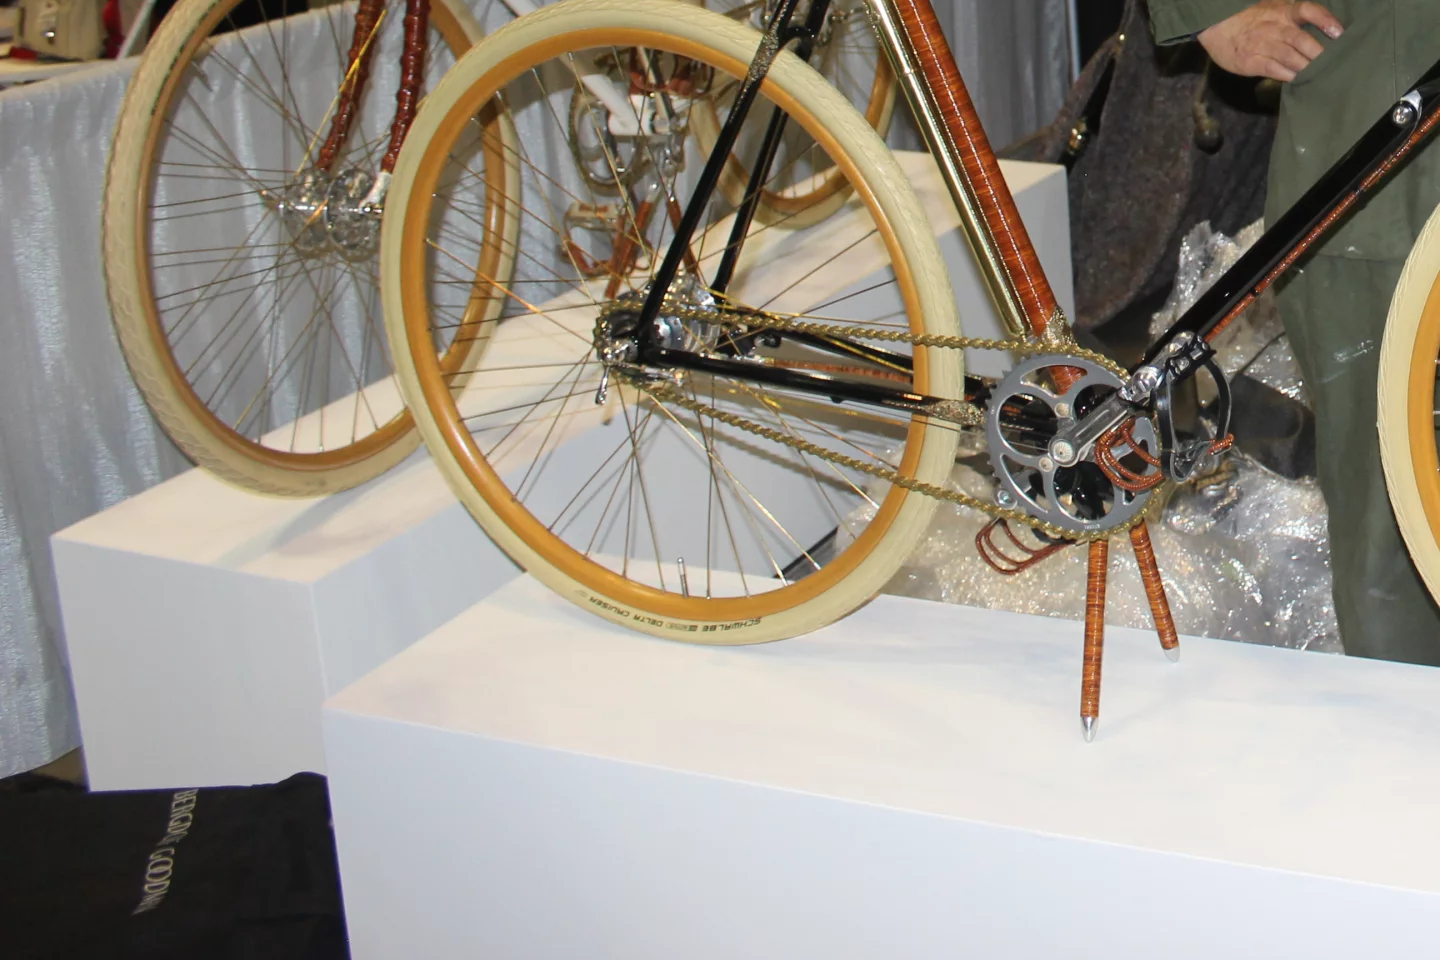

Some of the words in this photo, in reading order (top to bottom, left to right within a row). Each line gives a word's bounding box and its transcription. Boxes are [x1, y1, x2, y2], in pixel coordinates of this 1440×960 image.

[588, 595, 630, 618] CRUISER
[632, 613, 664, 628] DELTA
[701, 616, 762, 633] SCHWALBE
